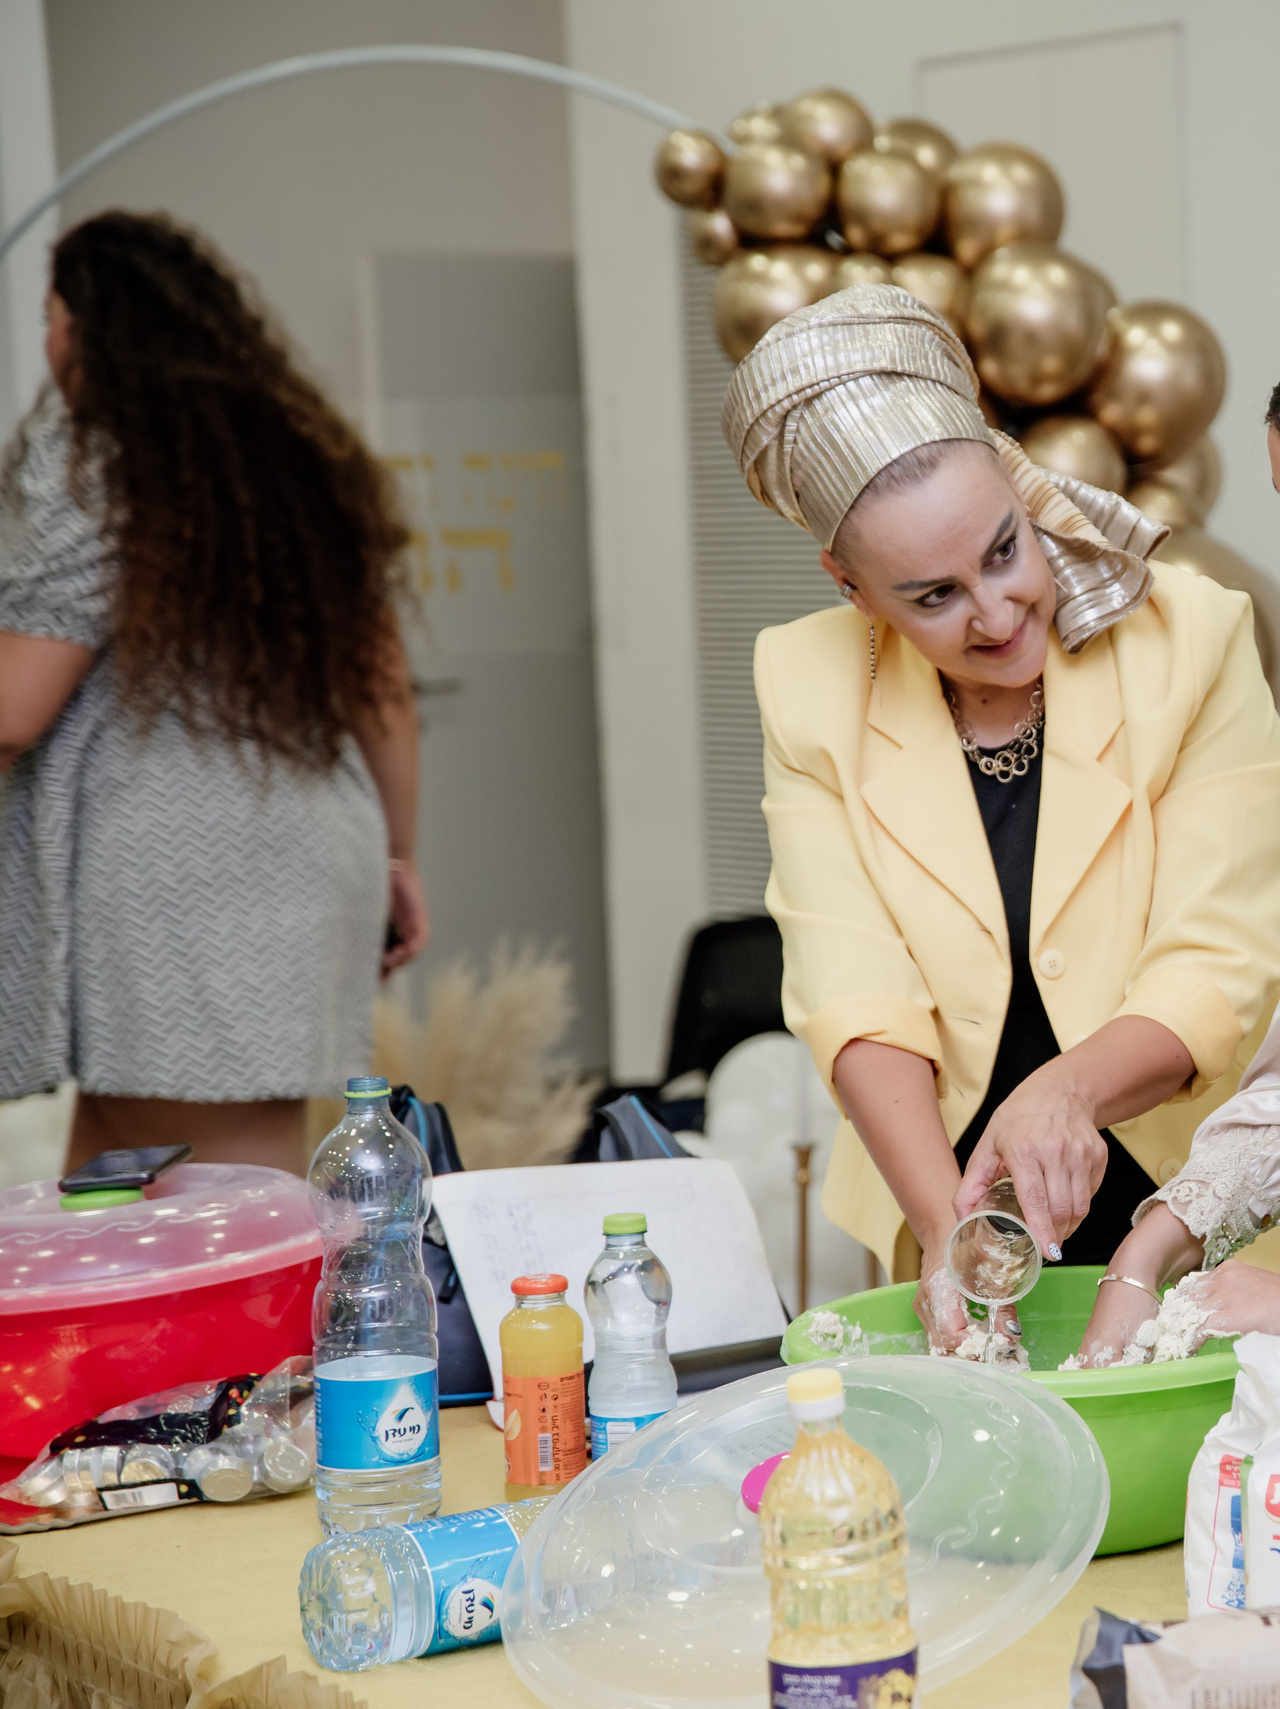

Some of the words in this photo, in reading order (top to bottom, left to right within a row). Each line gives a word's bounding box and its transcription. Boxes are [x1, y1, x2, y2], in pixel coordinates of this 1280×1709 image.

[384, 1427, 407, 1443] עדן
[408, 1424, 421, 1435] מי
[461, 1588, 476, 1613] עדן
[462, 1616, 475, 1630] מי
